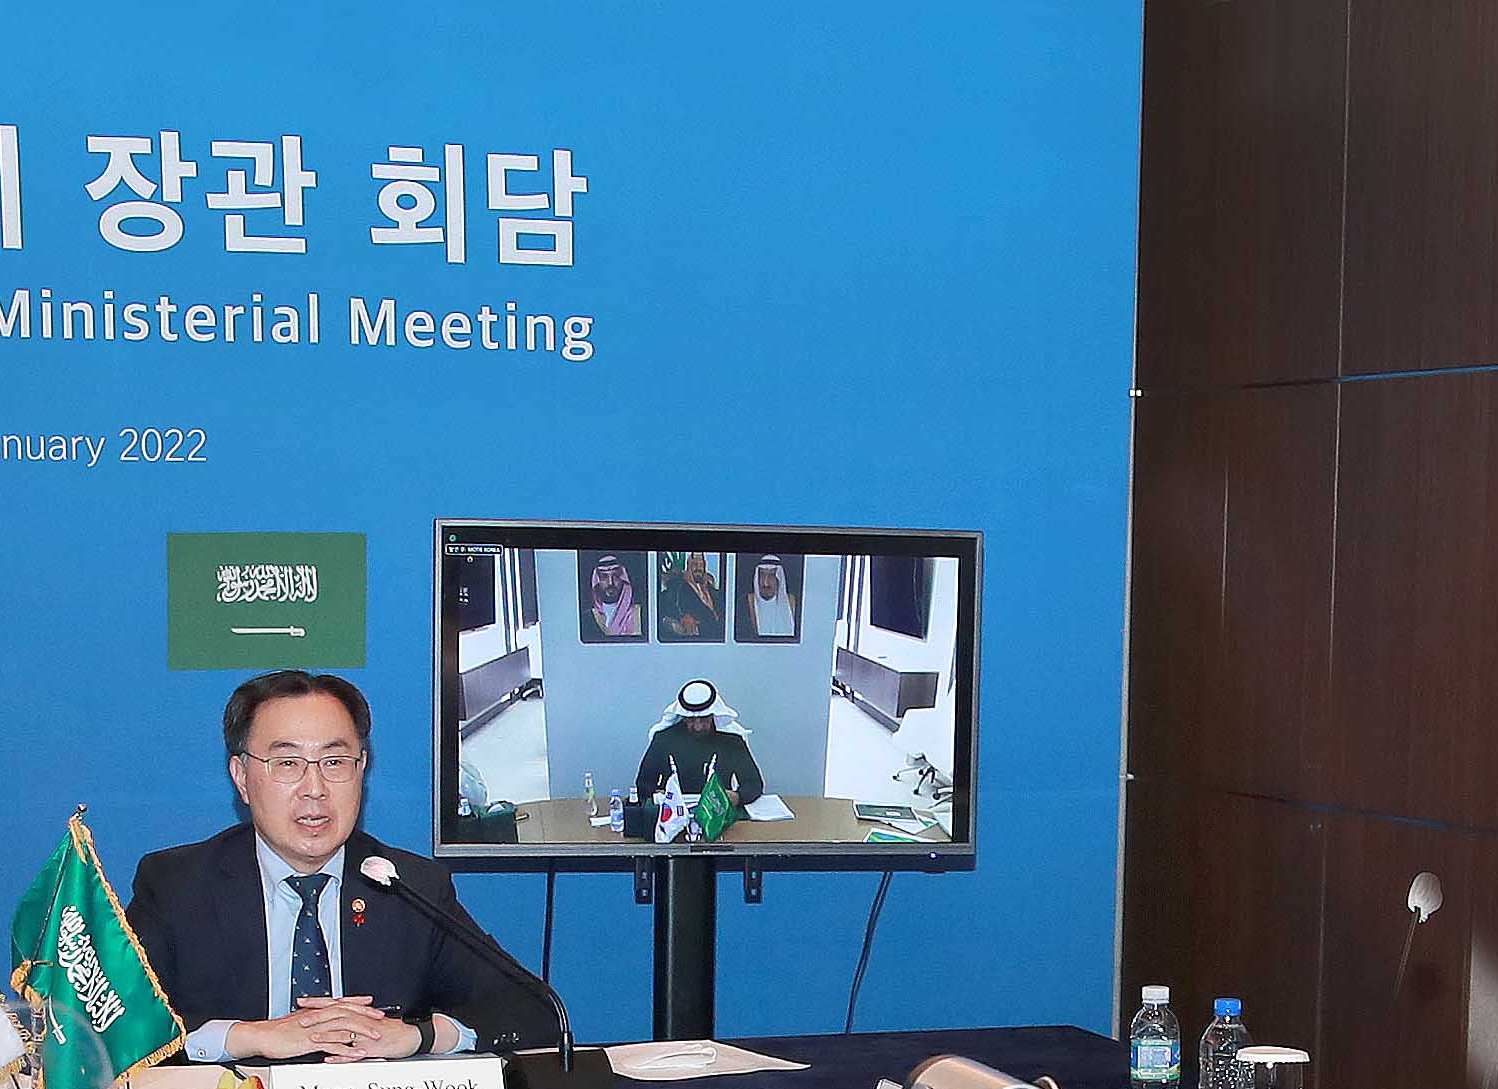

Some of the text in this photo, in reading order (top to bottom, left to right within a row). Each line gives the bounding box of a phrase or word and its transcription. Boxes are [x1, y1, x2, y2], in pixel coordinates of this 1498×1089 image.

[84, 130, 317, 254] 장관
[370, 143, 588, 266] 회담
[349, 297, 595, 362] Meeting
[119, 428, 208, 463] 2022
